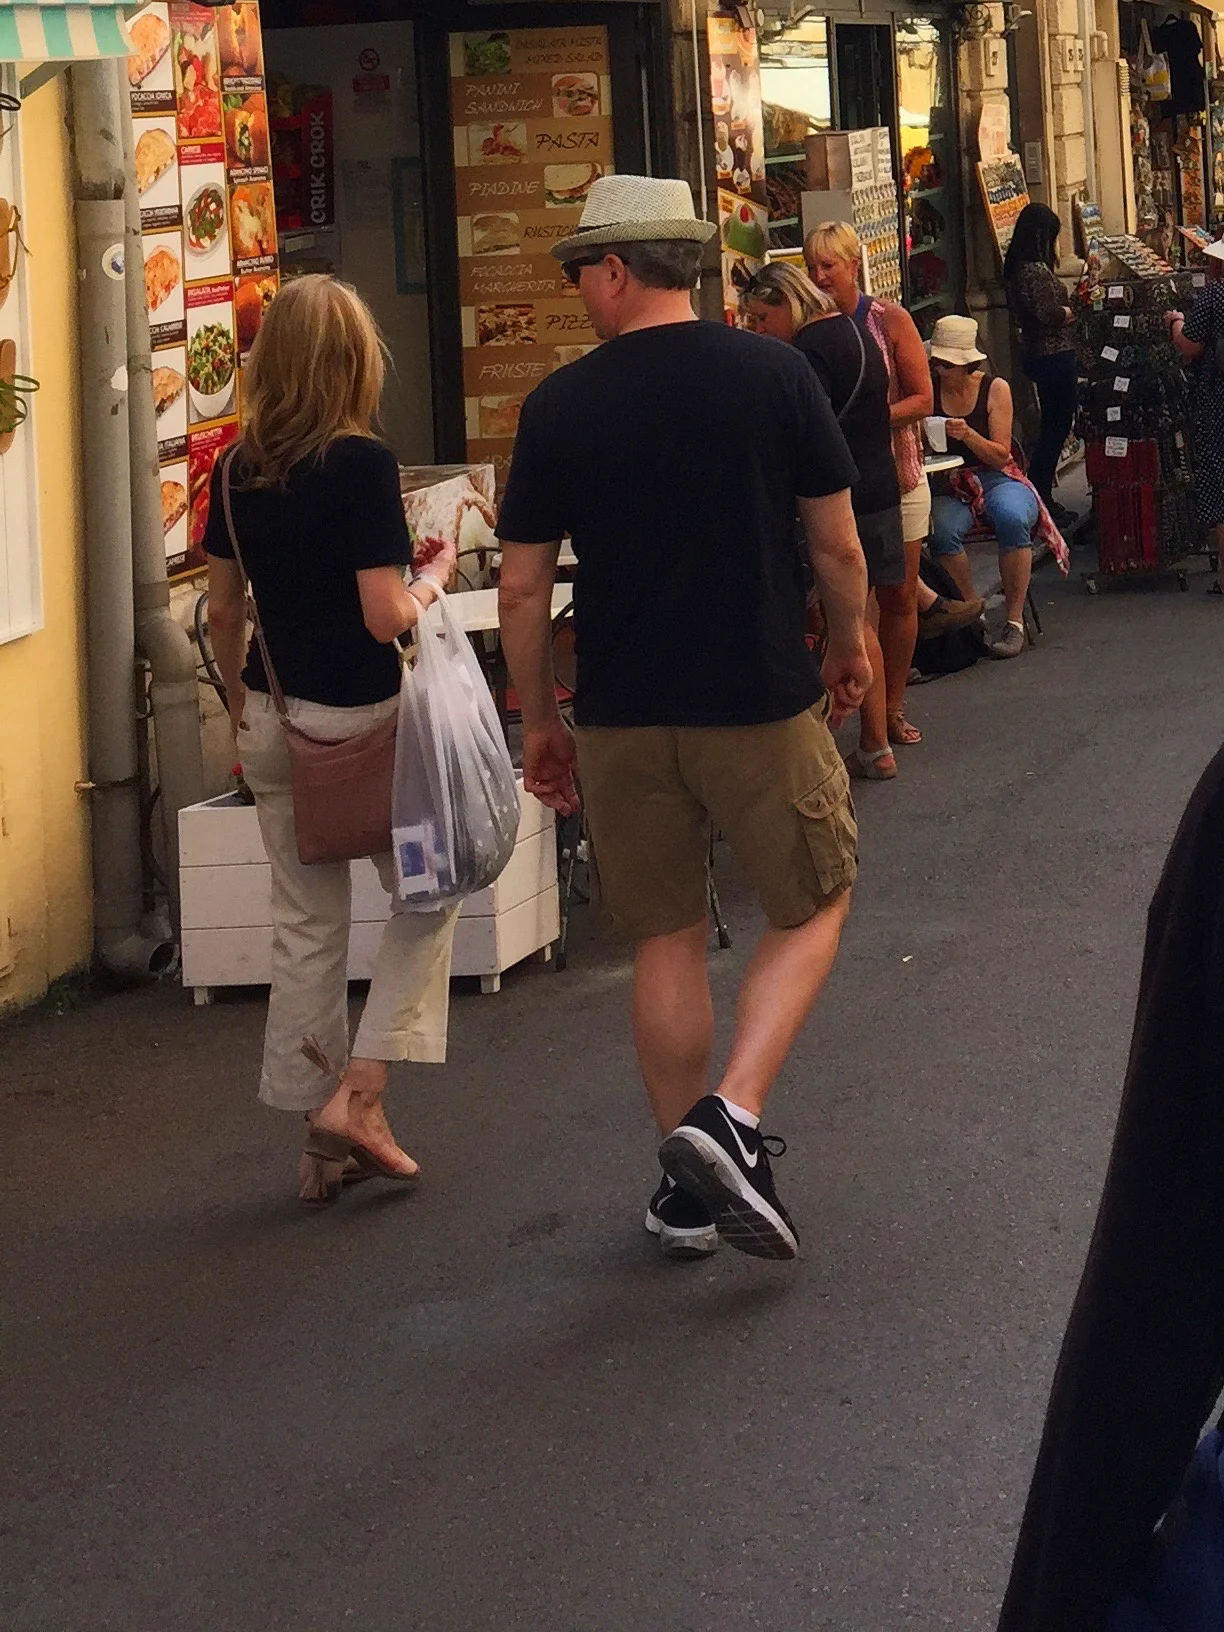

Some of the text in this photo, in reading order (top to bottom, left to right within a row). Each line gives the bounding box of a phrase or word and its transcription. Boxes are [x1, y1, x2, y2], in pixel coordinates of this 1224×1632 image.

[464, 82, 521, 97] PANINI
[464, 99, 544, 115] SANDWICH
[535, 131, 600, 151] PASTA
[310, 111, 326, 224] CRIK CROK
[469, 181, 540, 197] PIADINE
